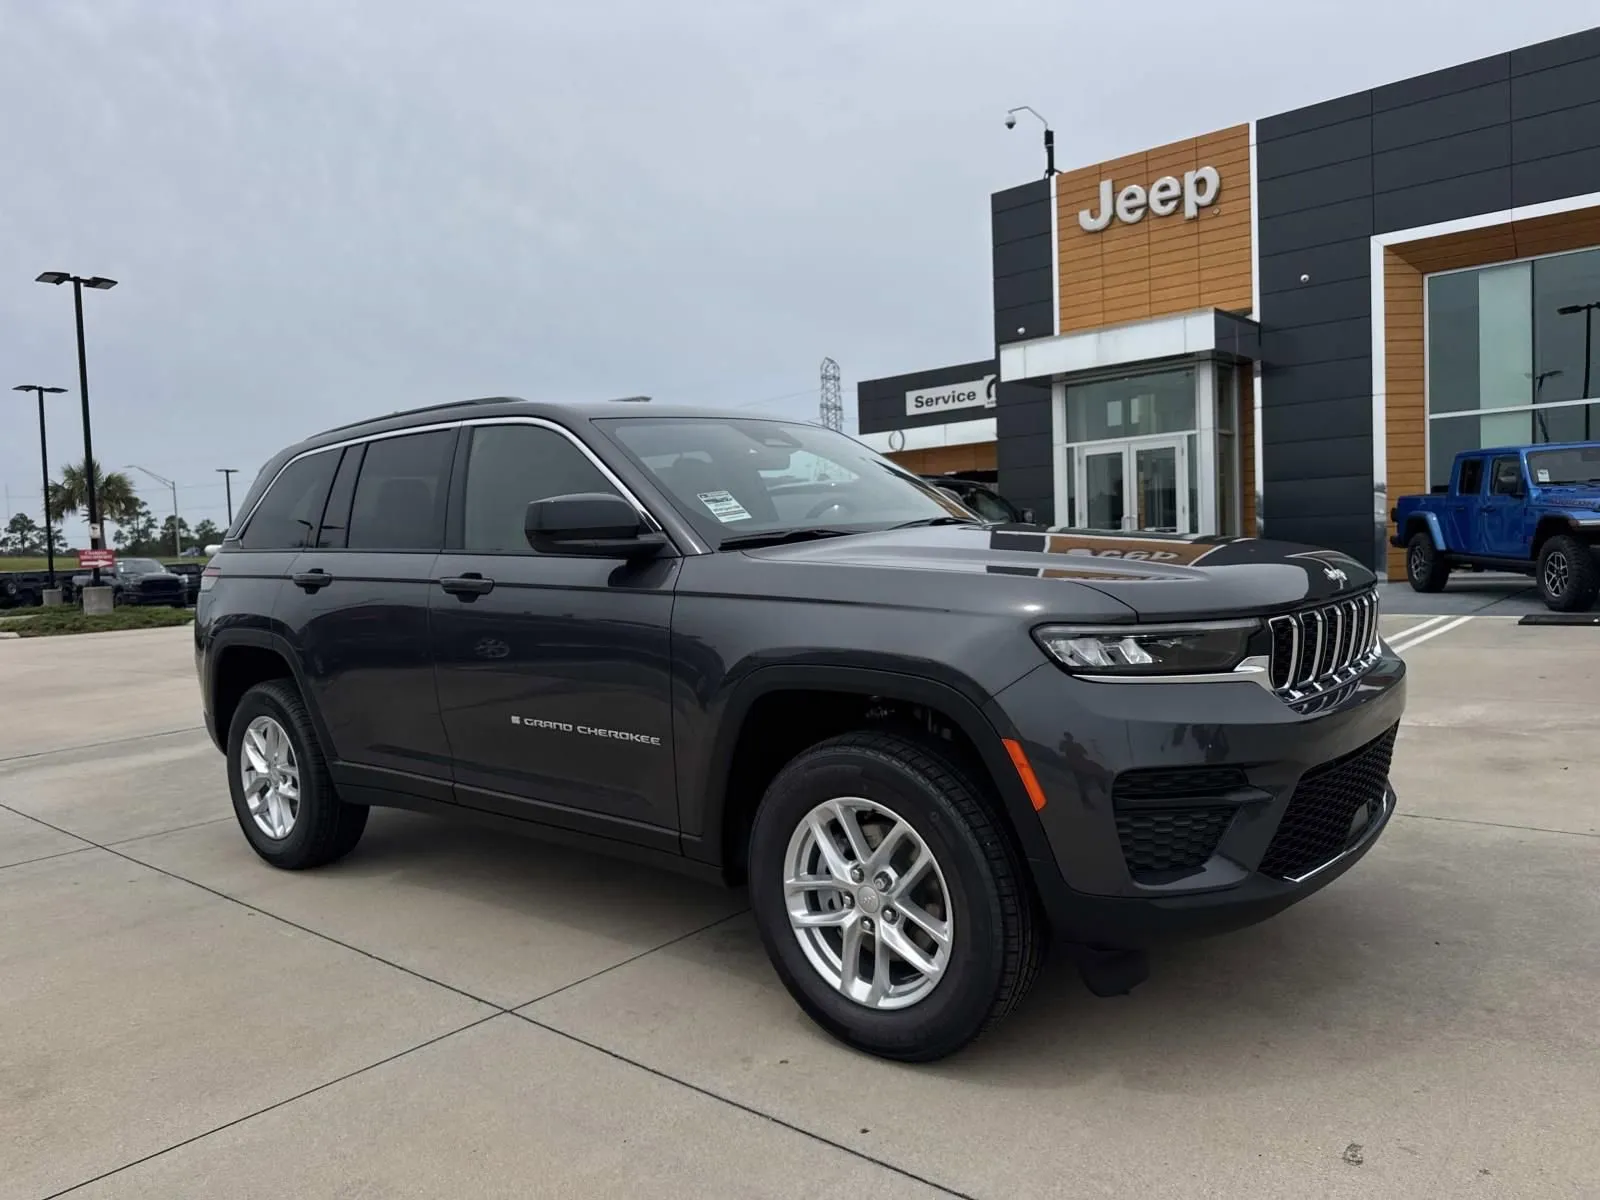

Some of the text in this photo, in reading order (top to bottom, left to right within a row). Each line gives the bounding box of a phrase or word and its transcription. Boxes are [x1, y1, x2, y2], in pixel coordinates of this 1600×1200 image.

[1078, 165, 1221, 233] Jeep
[914, 390, 977, 409] Service
[523, 717, 661, 746] GRAND CHEROKEE
